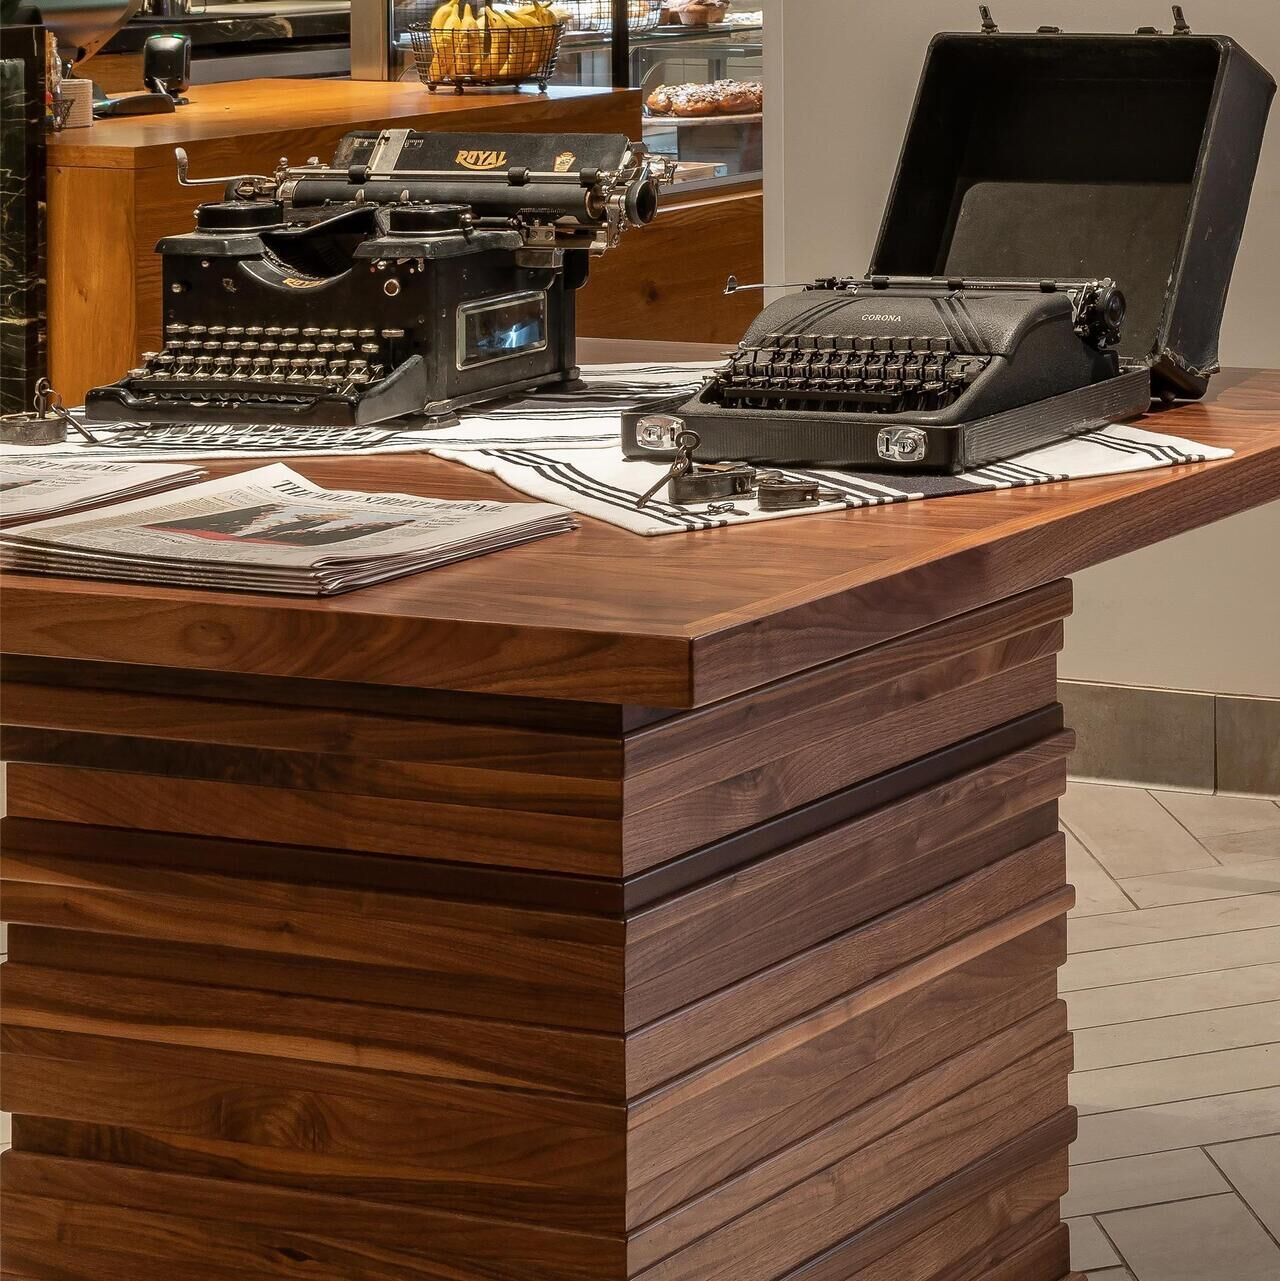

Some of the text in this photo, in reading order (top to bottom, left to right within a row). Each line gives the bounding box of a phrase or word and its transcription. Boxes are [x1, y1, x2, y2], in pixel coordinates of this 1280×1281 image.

[455, 150, 507, 170] ROYAL
[861, 314, 901, 322] CORONA
[271, 479, 313, 498] THE
